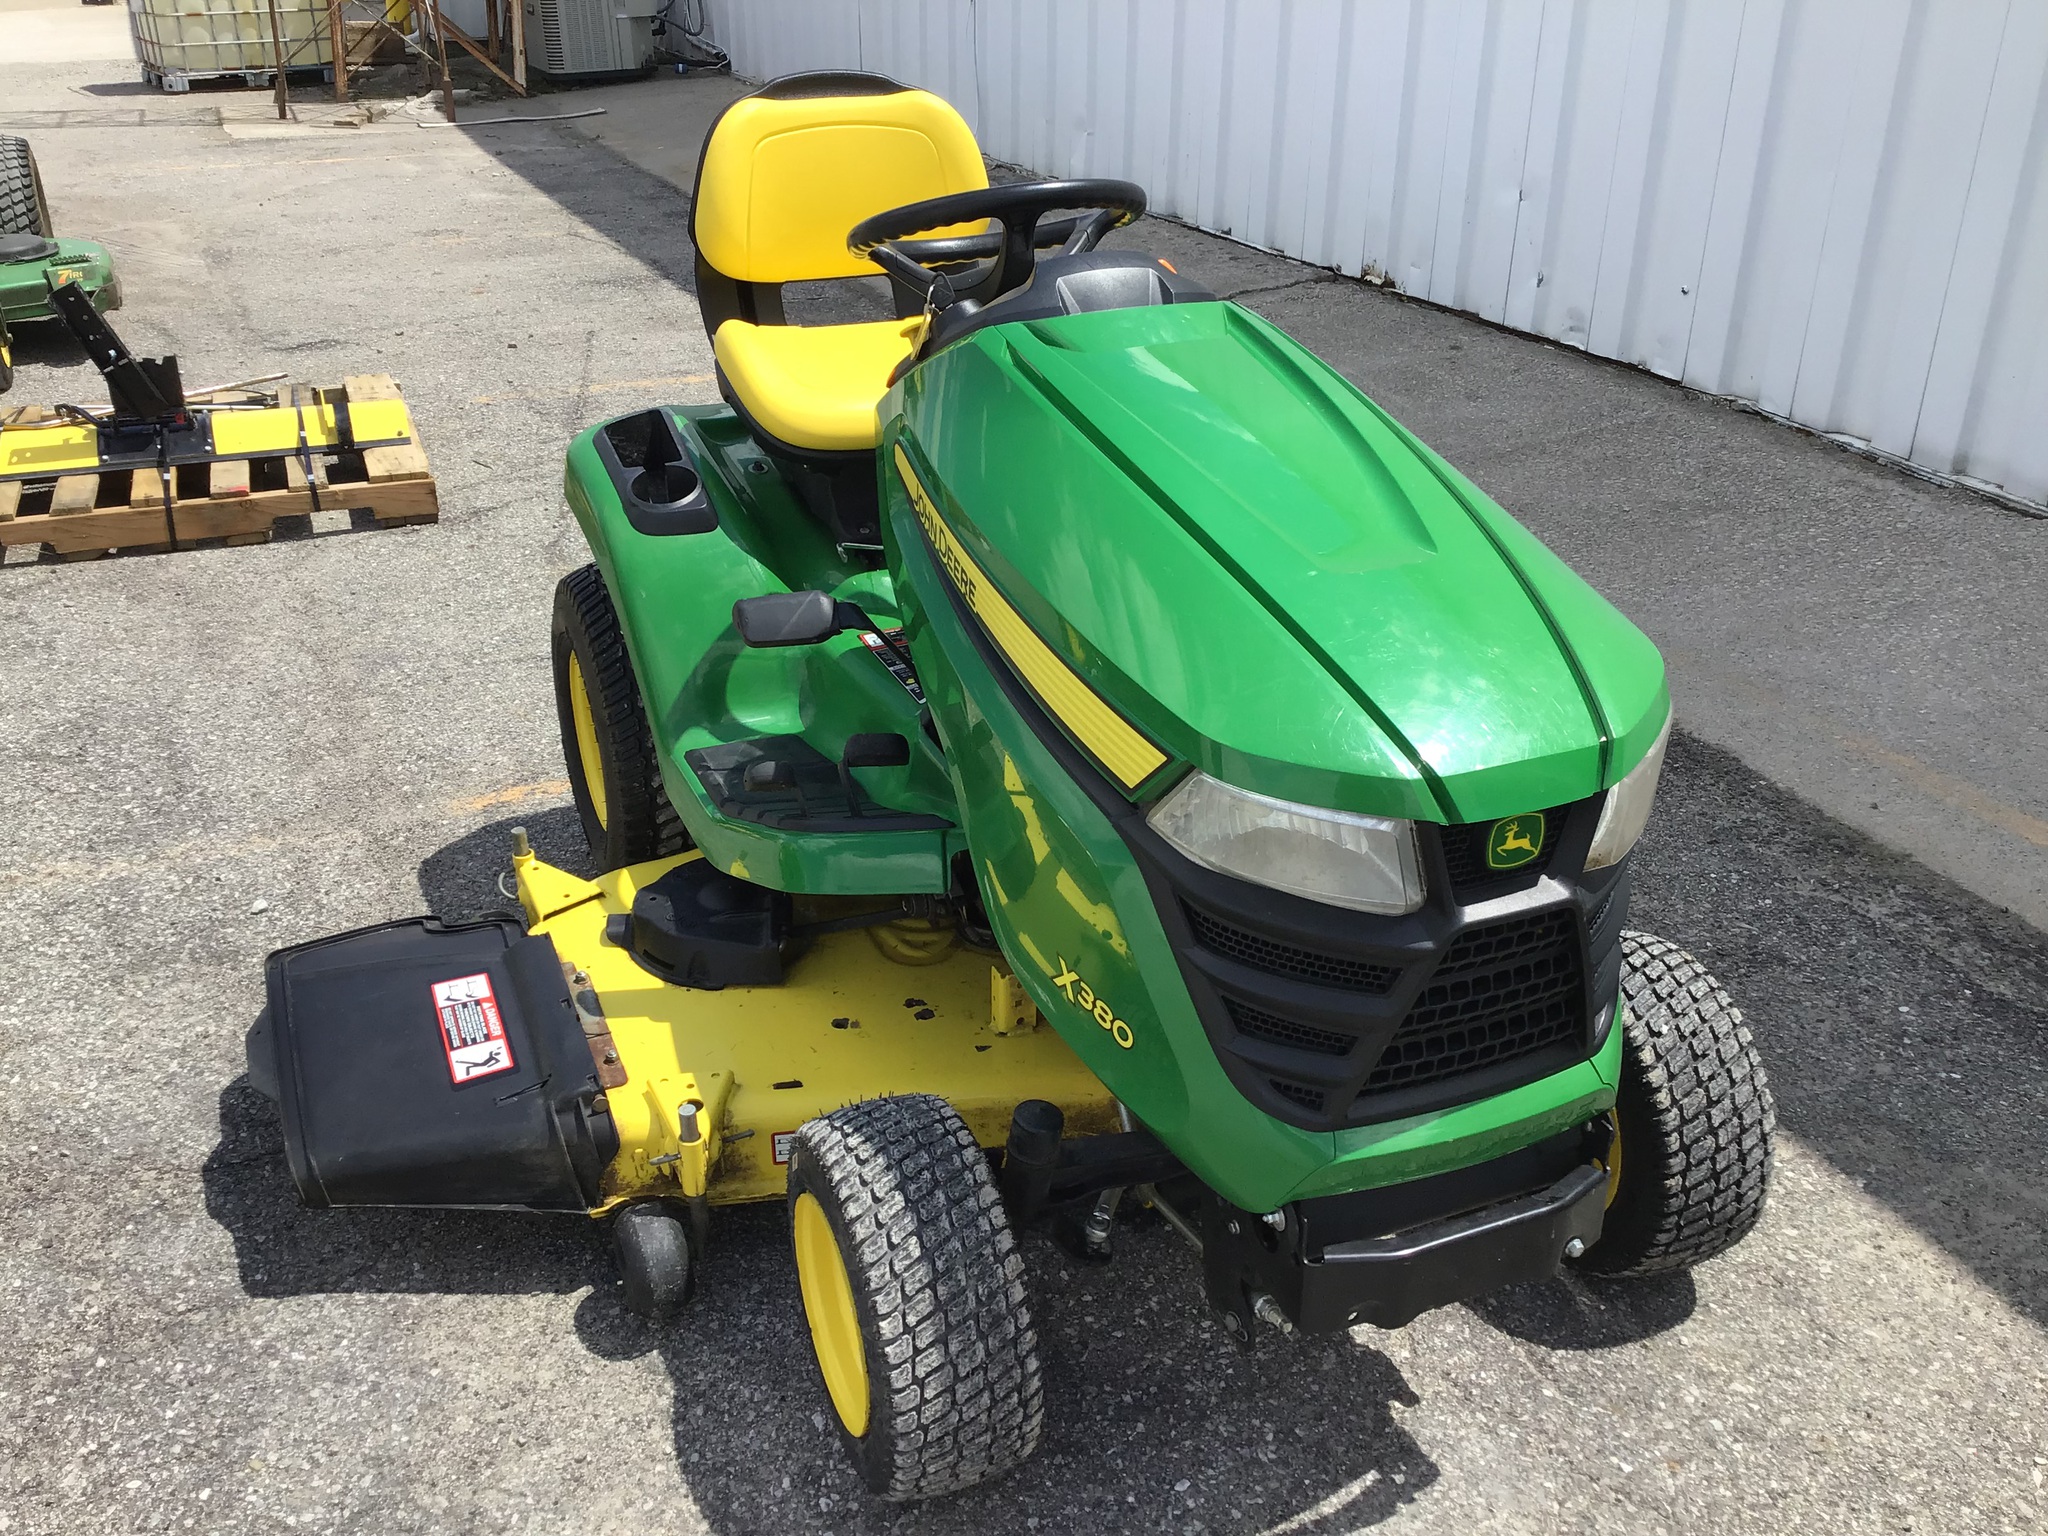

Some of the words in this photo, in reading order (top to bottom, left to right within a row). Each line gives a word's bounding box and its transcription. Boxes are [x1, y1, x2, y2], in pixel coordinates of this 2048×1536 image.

[914, 483, 938, 546] JOHN
[938, 525, 977, 609] DEERE
[486, 1007, 502, 1037] DANGER
[1052, 953, 1134, 1049] X380
